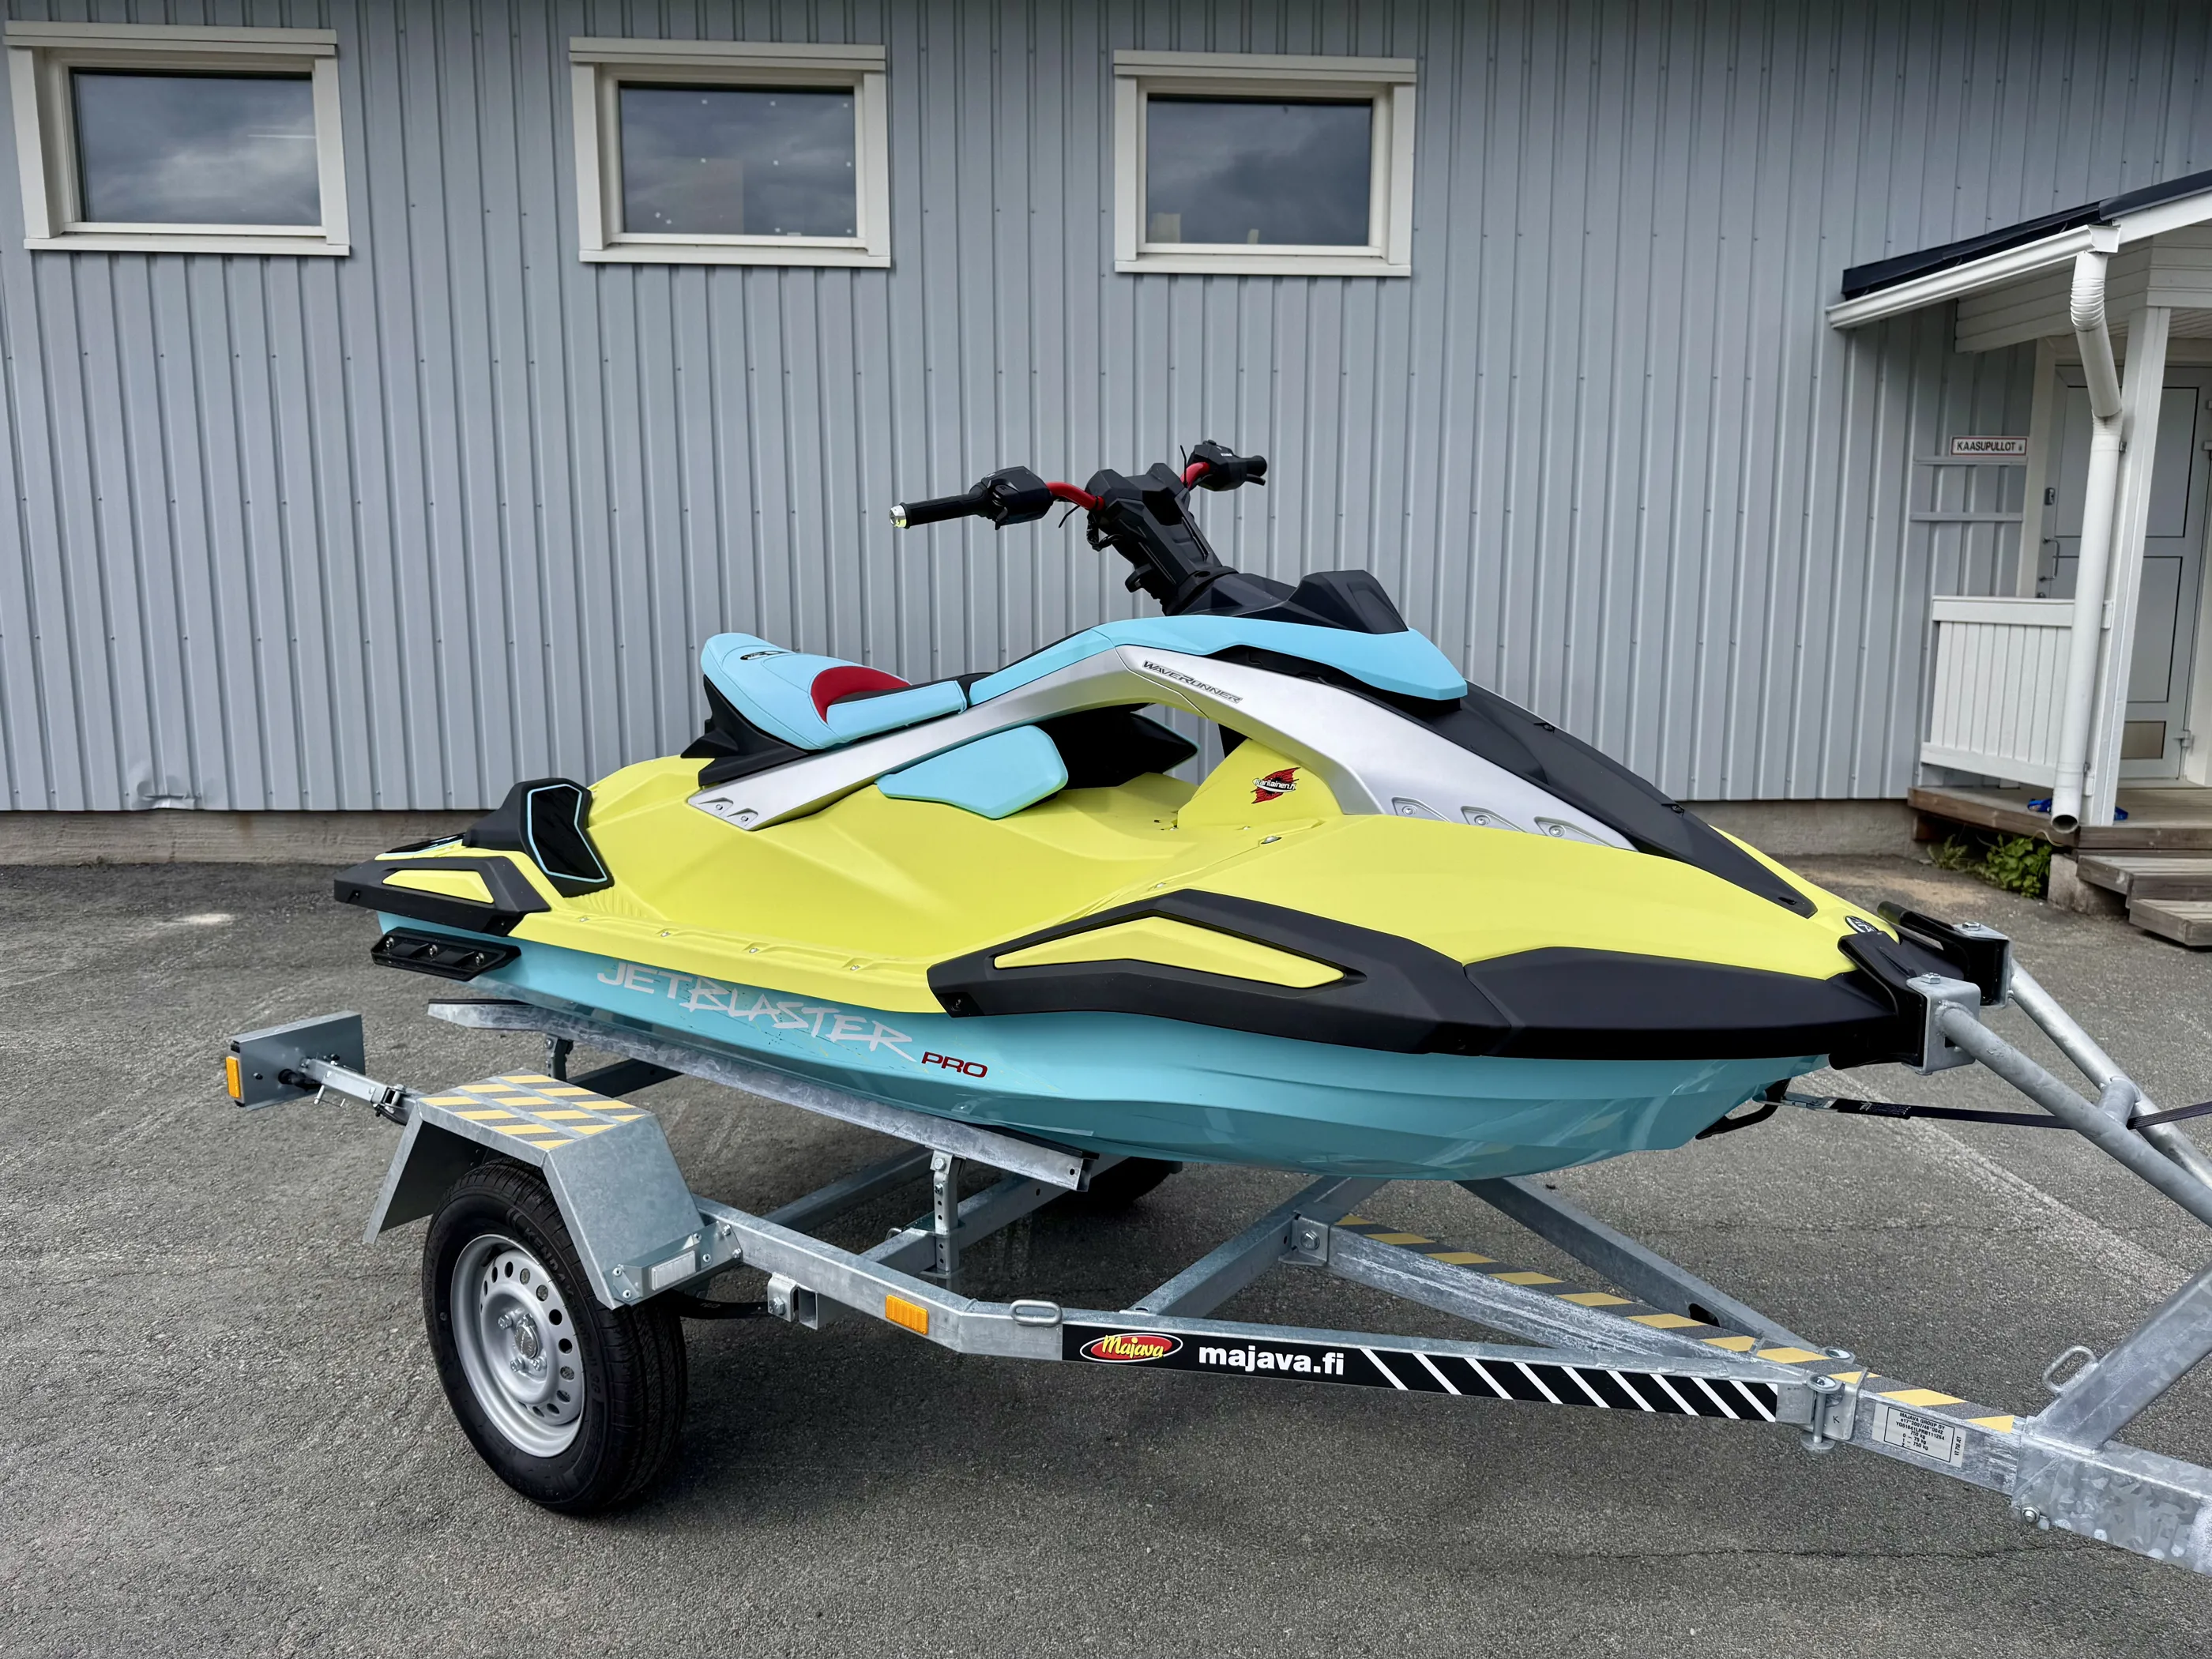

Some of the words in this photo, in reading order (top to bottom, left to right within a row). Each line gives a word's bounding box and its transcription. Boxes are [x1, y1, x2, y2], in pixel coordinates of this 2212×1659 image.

[1957, 442, 2015, 451] KAASUPULLOT
[597, 961, 917, 1062] JETBLASTER
[921, 1051, 988, 1078] PRO
[525, 1227, 567, 1282] KENDA
[1102, 1334, 1165, 1358] Majava
[1198, 1345, 1345, 1375] majava.fi
[1899, 1412, 1919, 1423] MAJAVA
[1920, 1418, 1938, 1428] GROUP
